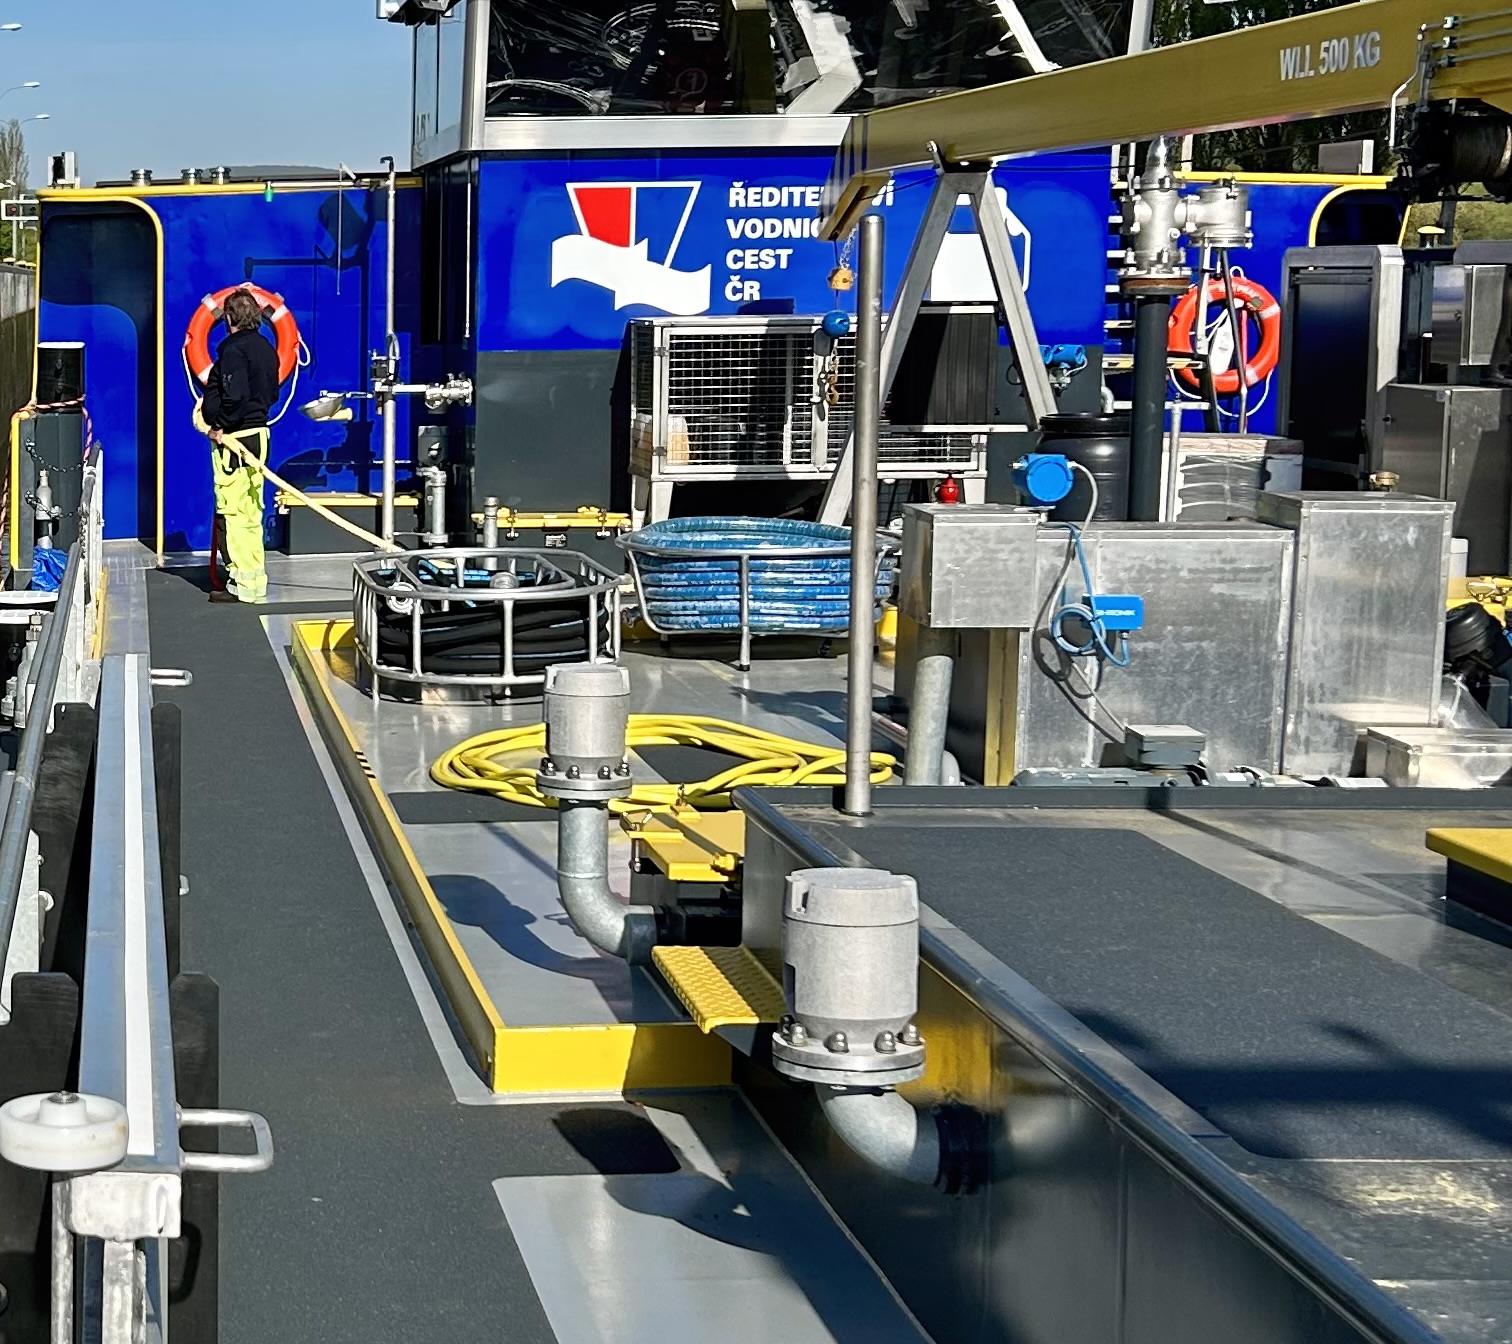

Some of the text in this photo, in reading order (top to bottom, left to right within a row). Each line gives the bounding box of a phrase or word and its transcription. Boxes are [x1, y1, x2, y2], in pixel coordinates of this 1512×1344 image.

[1279, 31, 1381, 82] WLL 500 KG
[725, 248, 793, 270] CEST
[724, 275, 761, 302] ČR
